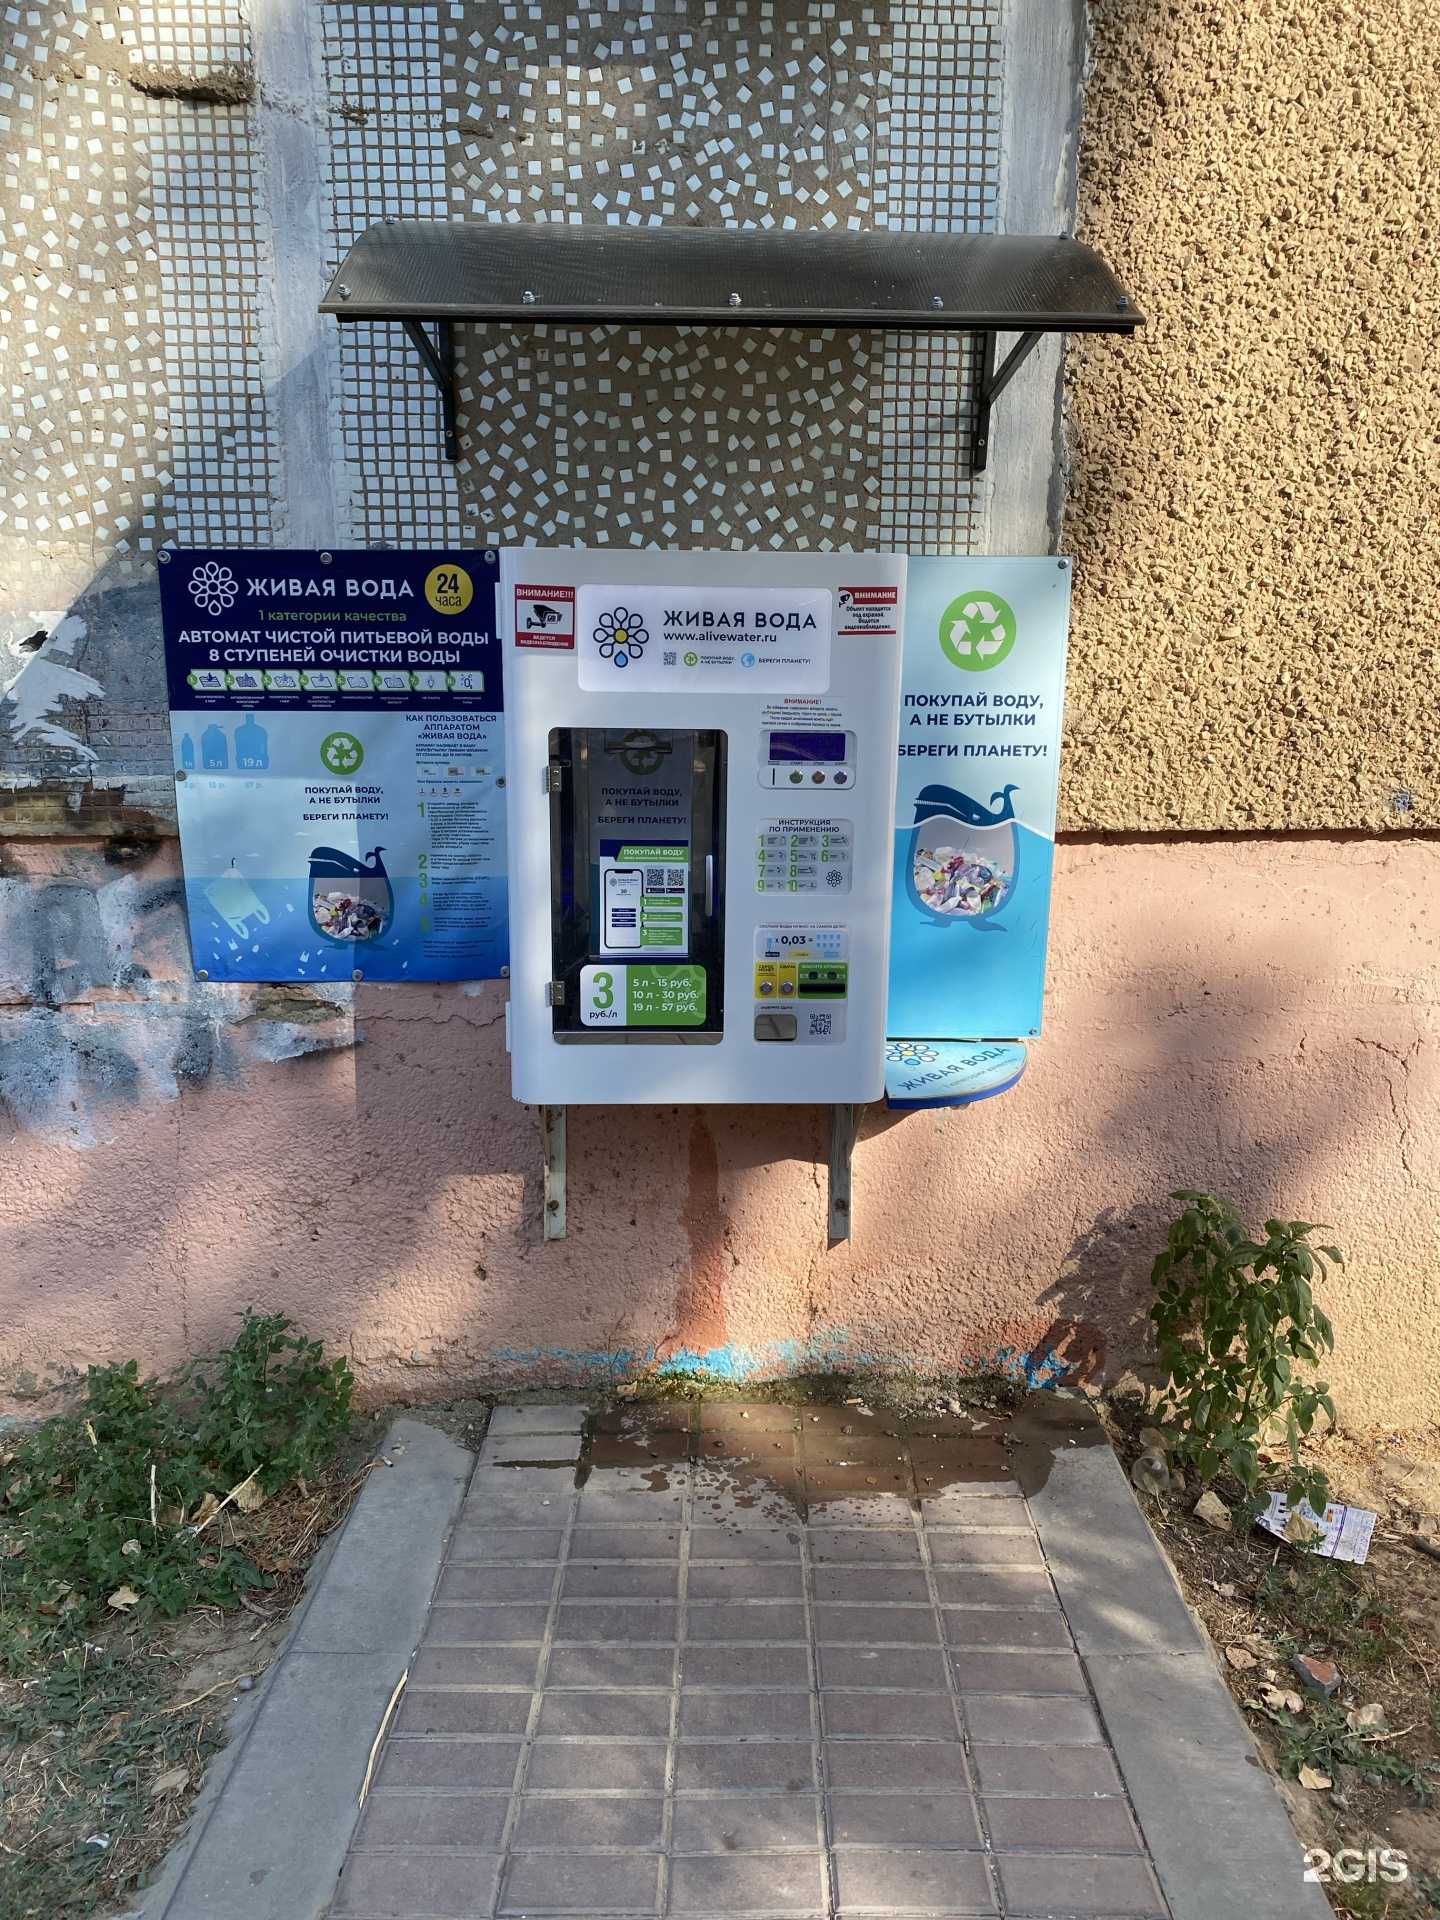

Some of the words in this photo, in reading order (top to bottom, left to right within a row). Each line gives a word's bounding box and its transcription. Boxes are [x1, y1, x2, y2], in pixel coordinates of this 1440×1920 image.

[246, 578, 340, 597] ЖИВАЯ
[346, 579, 414, 600] ВОДА
[436, 573, 459, 594] 24
[517, 589, 573, 598] ВНИМАНИЕ!!!
[435, 595, 462, 607] часа
[258, 610, 264, 622] 1
[268, 610, 340, 624] категории
[344, 611, 407, 622] качества
[664, 610, 744, 627] ЖИВАЯ
[756, 612, 816, 630] ВОДА
[178, 630, 260, 644] АВТОМАТ
[265, 628, 335, 644] ЧИСТОЙ
[341, 629, 432, 645] ПИТЬЕВОЙ
[438, 632, 488, 646] ВОДЫ
[664, 631, 777, 642] www.alivewater.ru
[209, 649, 219, 662] 8
[224, 647, 316, 662] СТУПЕНЕЙ
[320, 649, 402, 663] ОЧИСТКИ
[408, 650, 460, 666] ВОДЫ
[904, 692, 988, 706] ПОКУПАЙ
[993, 695, 1044, 709] ВОДУ,
[910, 714, 922, 726] А
[927, 714, 948, 726] НЕ
[954, 714, 1036, 726] БУТЫЛКИ
[898, 745, 958, 757] БЕРЕГИ
[964, 745, 1048, 757] ПЛАНЕТУ!
[304, 785, 352, 794] ПОКУПАЙ
[602, 786, 650, 796] ПОКУПАЙ
[654, 788, 682, 796] ВОДУ,
[418, 802, 424, 818] 1
[791, 834, 798, 847] 2
[822, 834, 829, 847] 3
[418, 854, 428, 868] 2
[758, 850, 765, 862] 4
[790, 850, 798, 862] 5
[822, 850, 828, 862] 6
[758, 864, 765, 877] 7
[790, 864, 796, 877] 8
[758, 880, 764, 892] 9
[781, 936, 806, 946] 0,03
[658, 978, 668, 987] 15
[670, 978, 692, 988] руб.
[592, 972, 614, 1008] 3
[633, 990, 644, 998] 10
[662, 990, 674, 998] 30
[678, 990, 698, 1000] руб.
[676, 1002, 698, 1012] руб.
[590, 1010, 618, 1018] руб./л
[896, 1064, 964, 1090] ЖИВАЯ
[960, 1047, 1010, 1066] ВОДА
